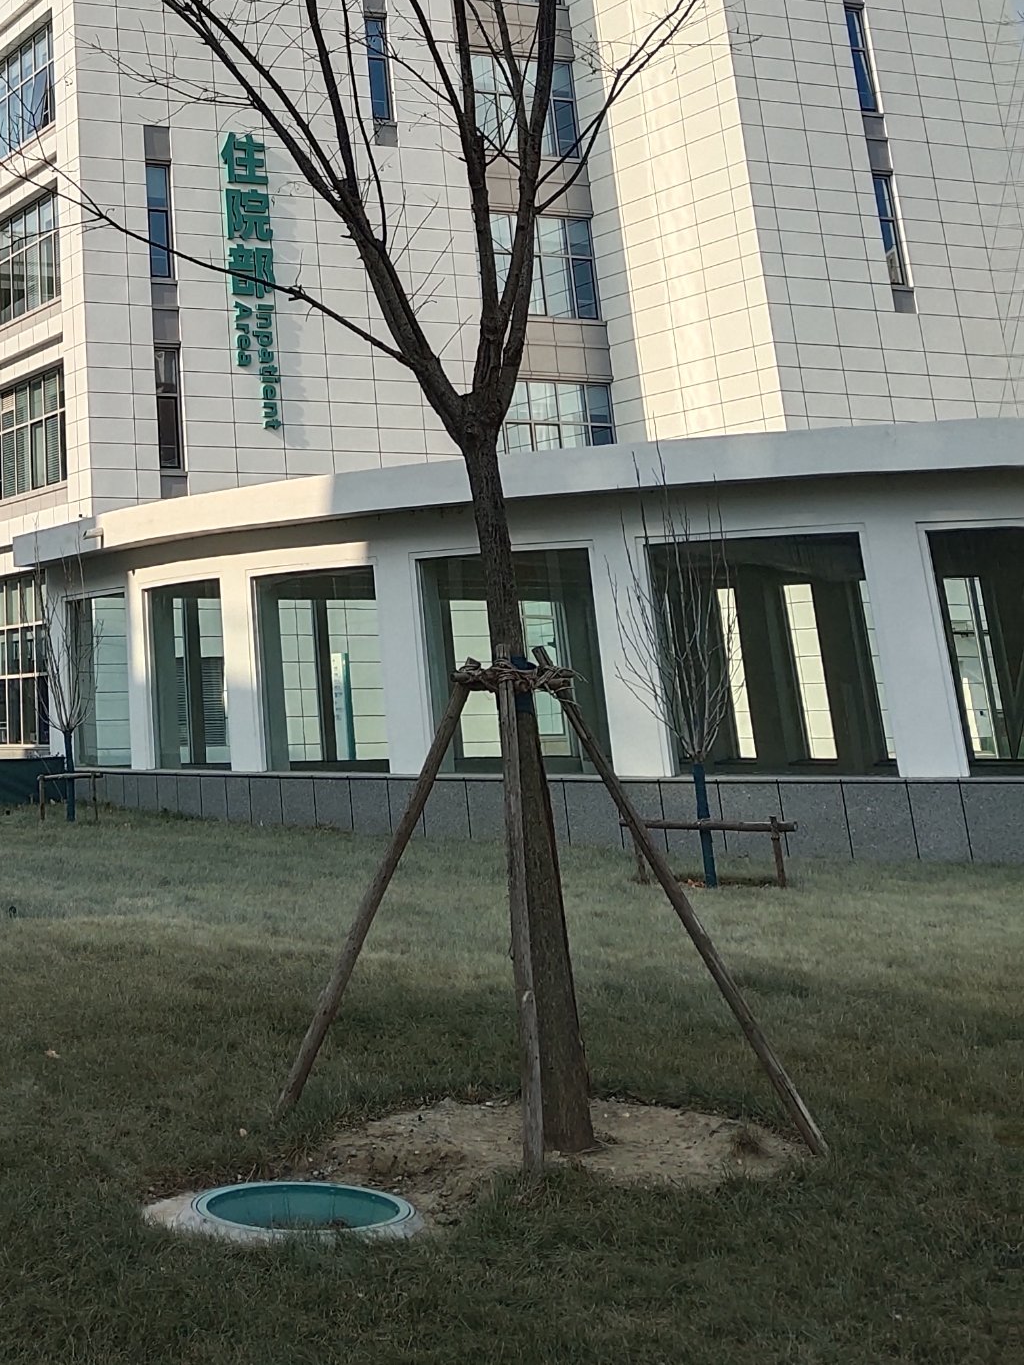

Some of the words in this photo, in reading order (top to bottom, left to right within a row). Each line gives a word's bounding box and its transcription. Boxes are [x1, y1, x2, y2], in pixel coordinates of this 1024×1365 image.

[221, 132, 275, 298] 住院部
[234, 300, 253, 367] Area
[252, 303, 282, 430] Inpatient
